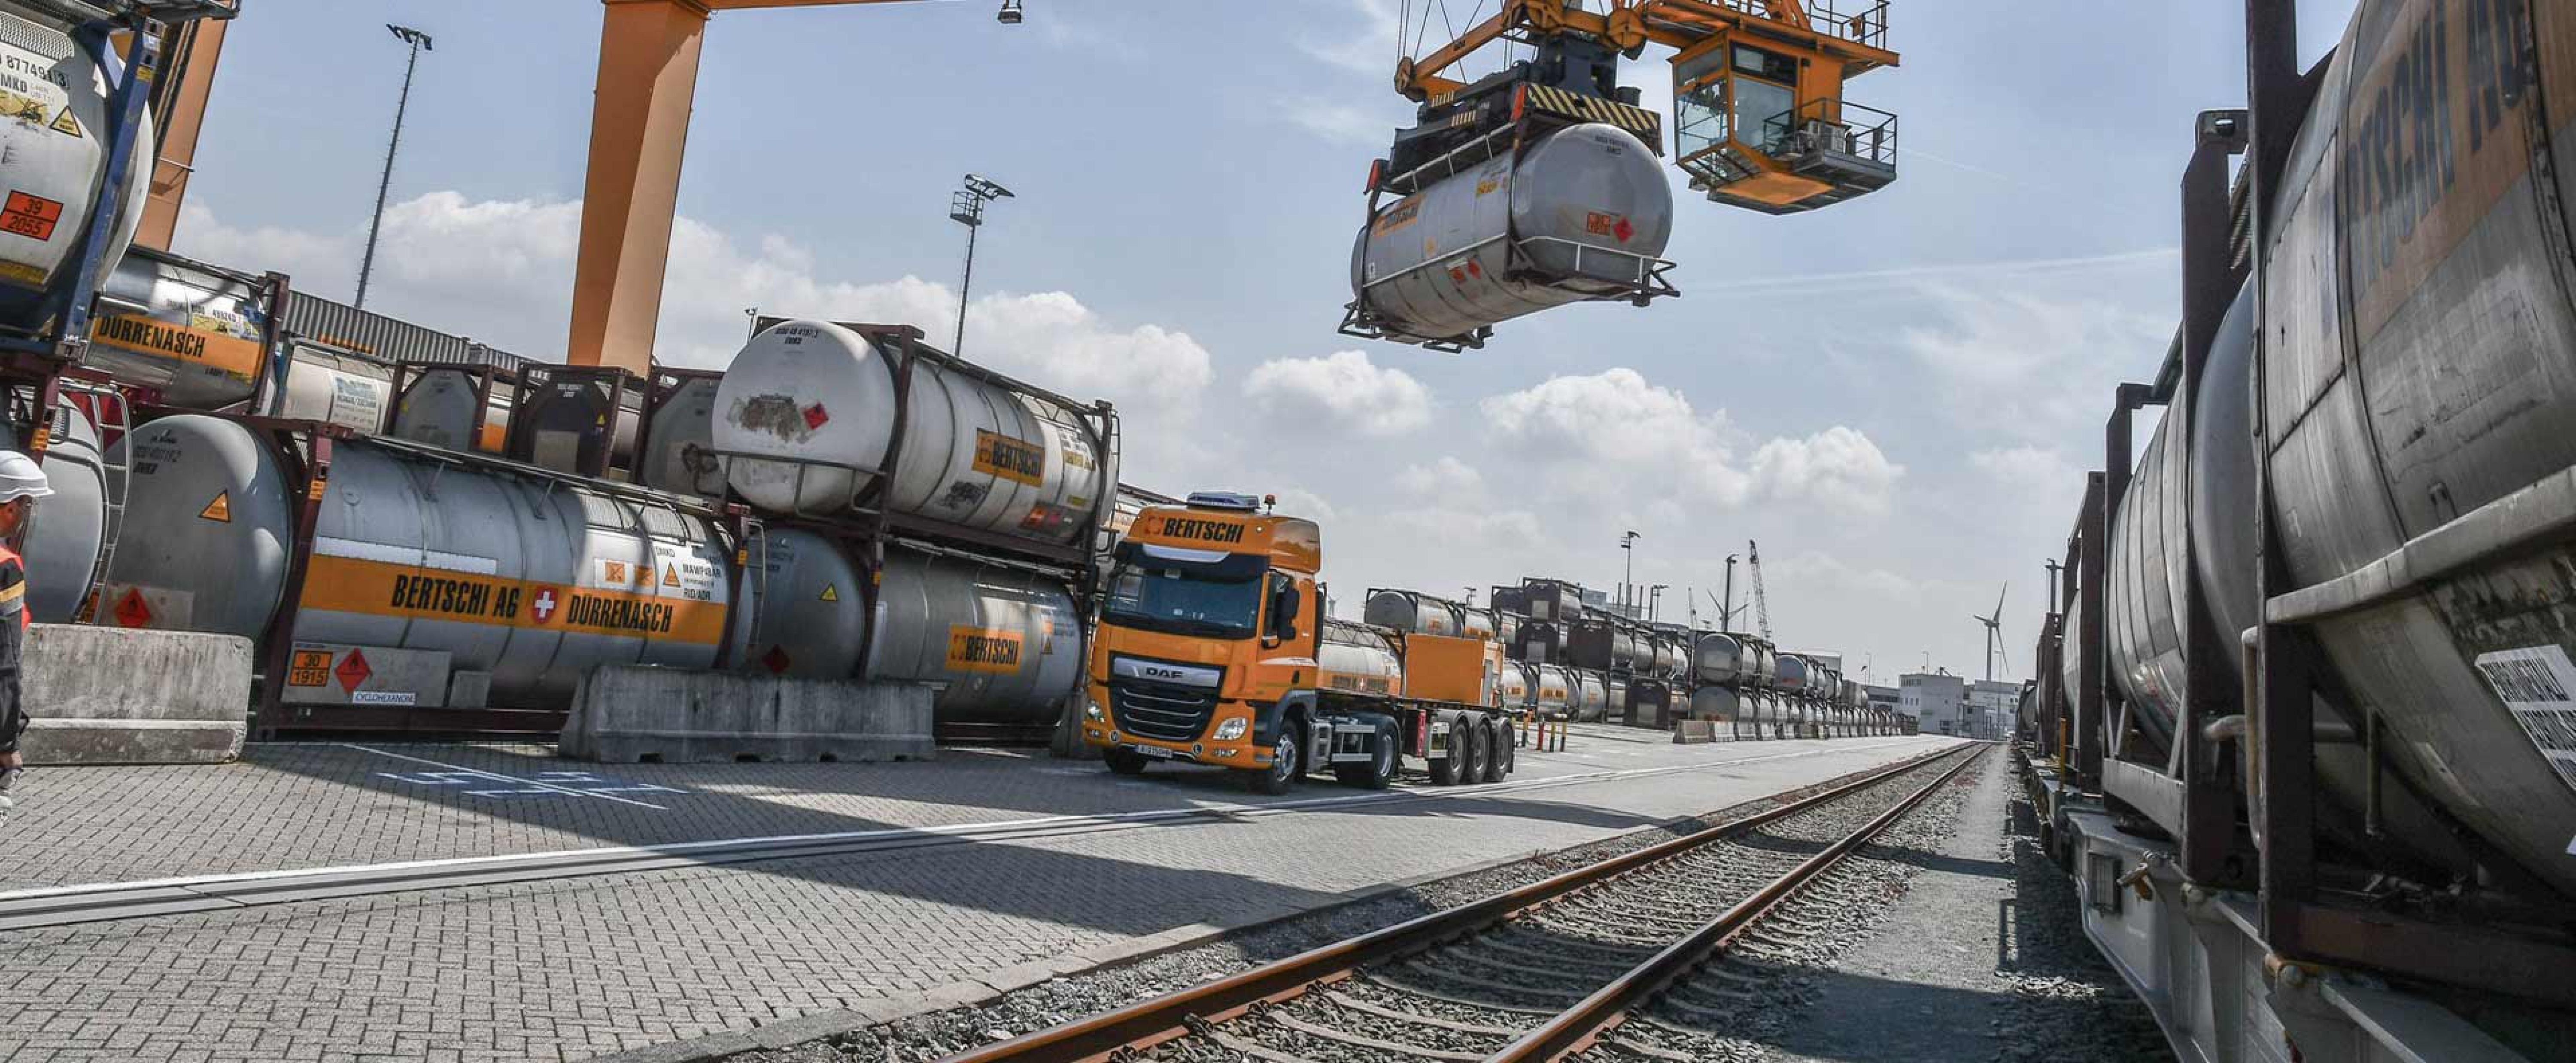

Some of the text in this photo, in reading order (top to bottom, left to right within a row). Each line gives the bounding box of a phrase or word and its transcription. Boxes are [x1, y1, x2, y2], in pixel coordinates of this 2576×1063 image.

[24, 198, 43, 215] 39
[7, 215, 41, 234] 2055
[992, 441, 1041, 478] BERTSCHI
[1162, 517, 1245, 544] BERTSCHI
[390, 574, 491, 616] BERTSCHI
[492, 586, 520, 618] AG
[966, 634, 1019, 666] BERTSCHI
[304, 654, 320, 667] 30
[295, 669, 326, 683] 1915
[1147, 667, 1184, 679] DAF
